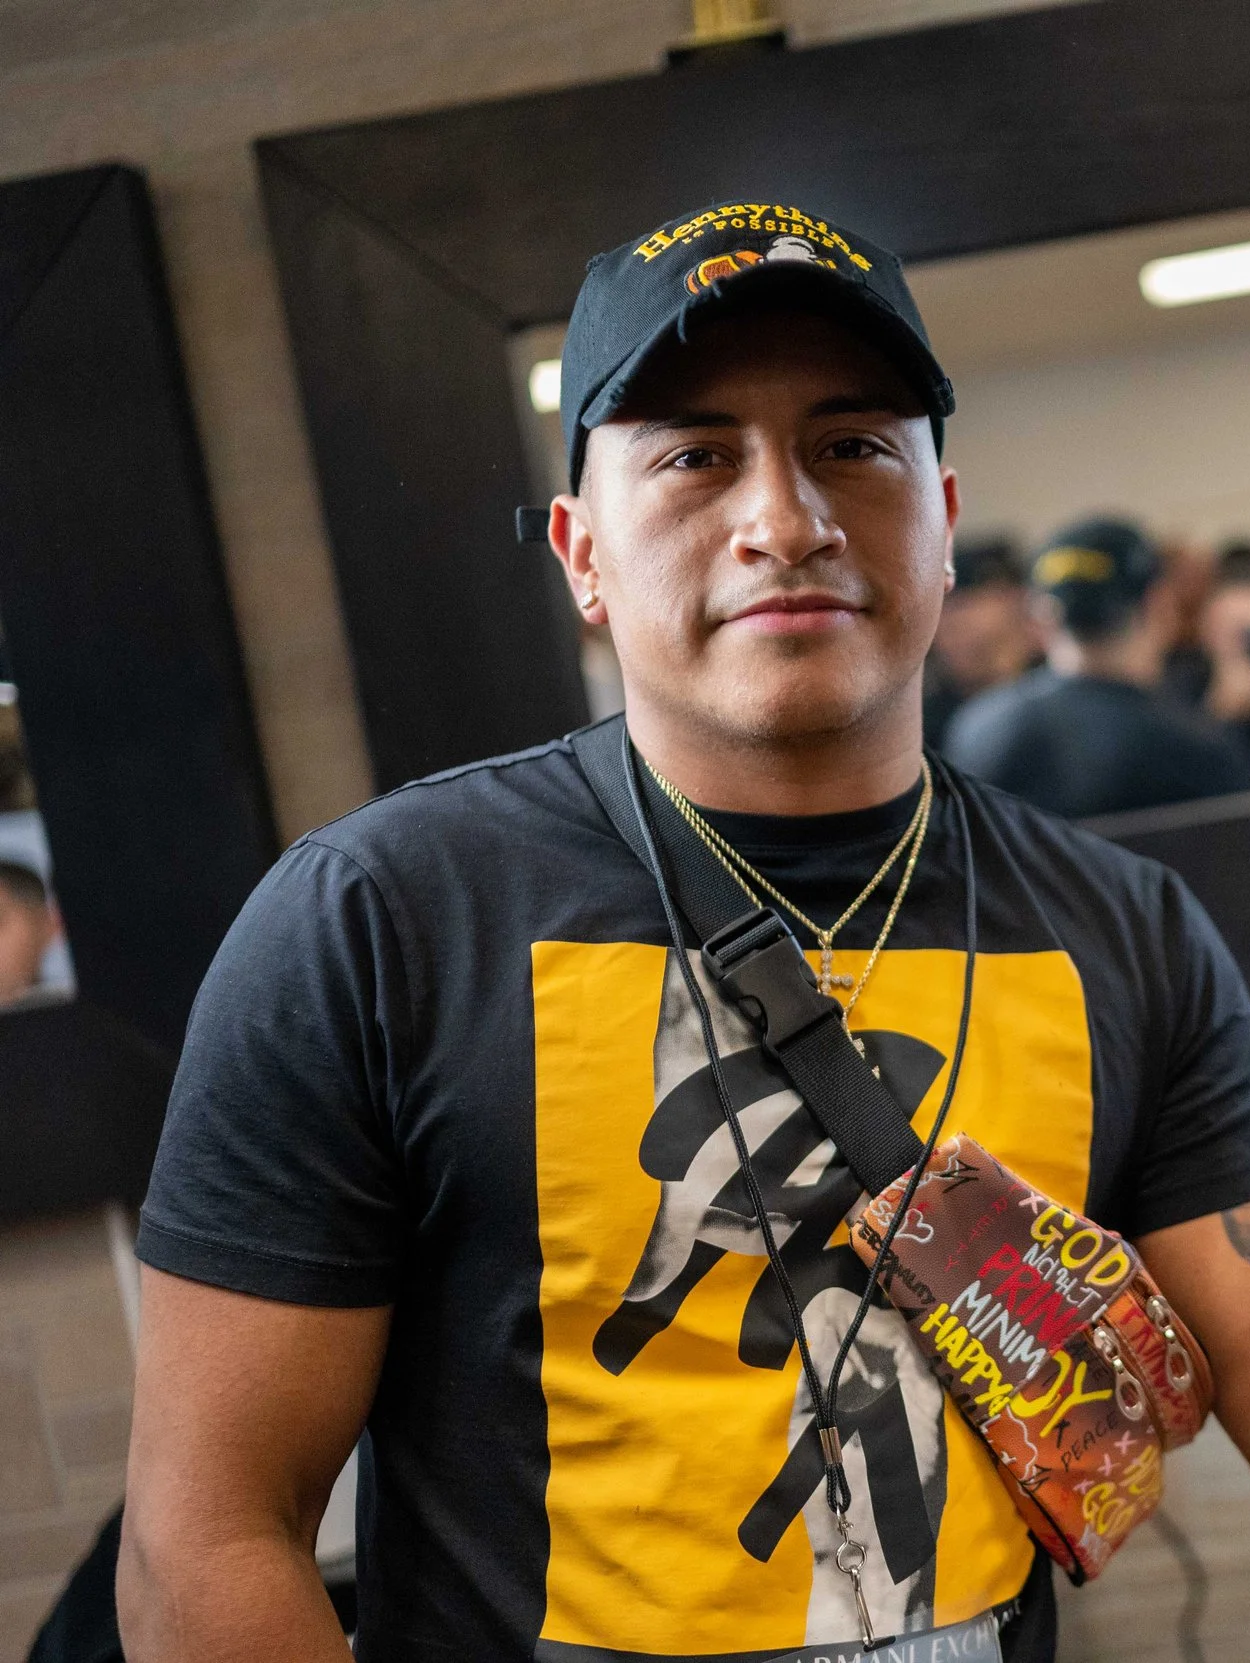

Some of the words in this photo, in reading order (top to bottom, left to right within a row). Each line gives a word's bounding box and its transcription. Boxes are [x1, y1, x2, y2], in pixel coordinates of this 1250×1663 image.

[713, 218, 835, 249] POSSIBLE
[1031, 1205, 1130, 1286] GOD
[920, 1303, 1014, 1405] HAPPY
[950, 1280, 1047, 1381] MINIM
[1061, 1409, 1118, 1473] PEACE
[796, 1643, 914, 1663] MANI
